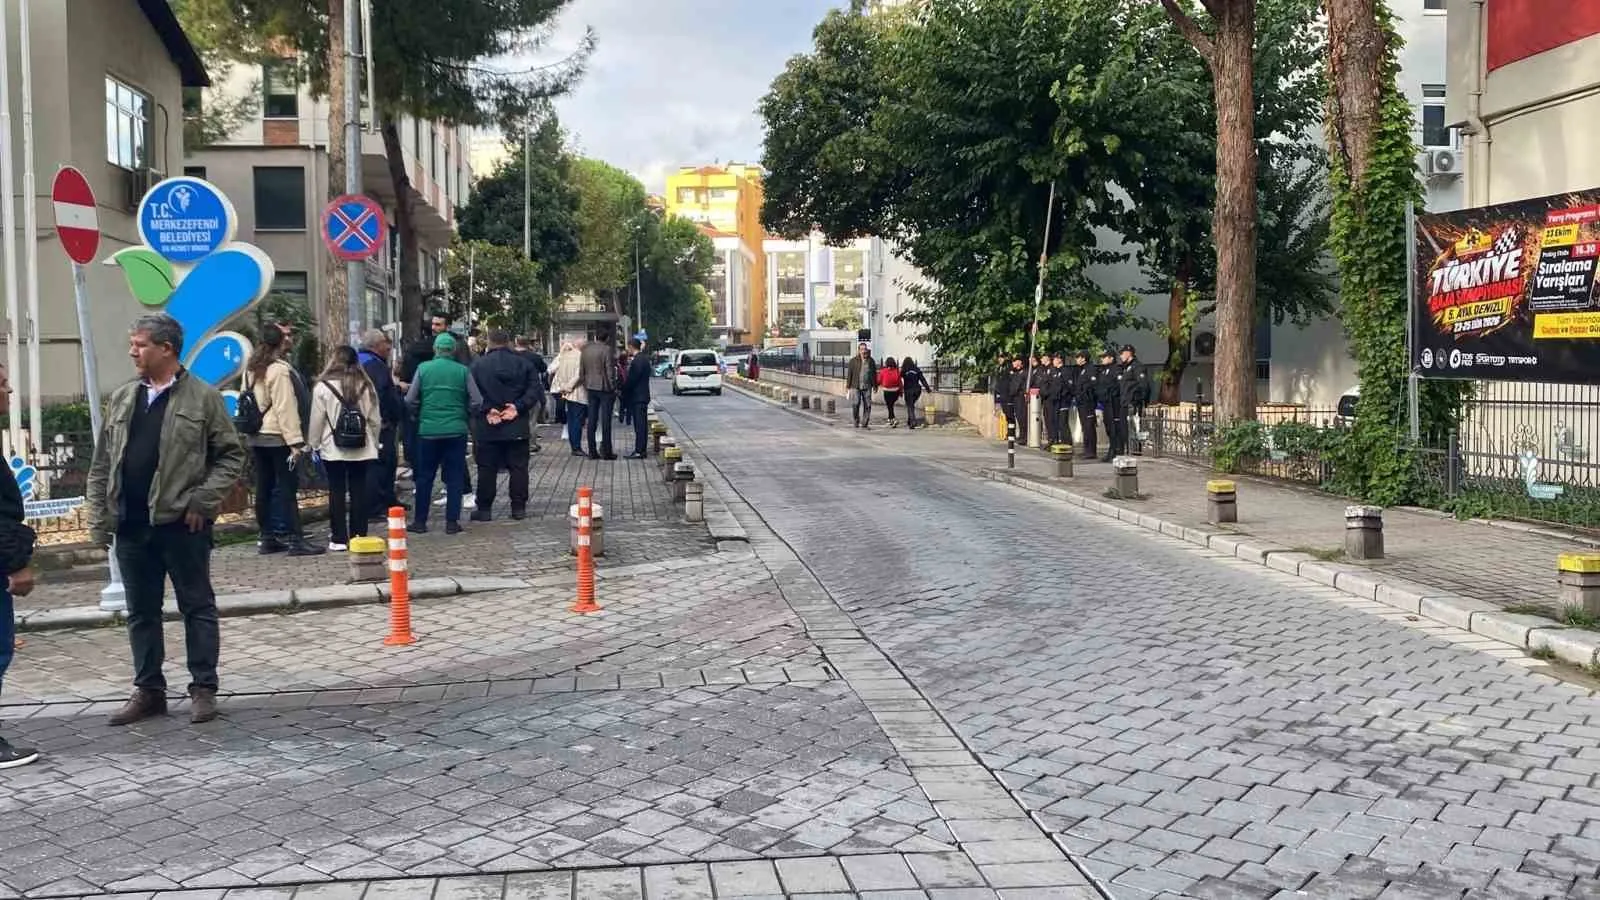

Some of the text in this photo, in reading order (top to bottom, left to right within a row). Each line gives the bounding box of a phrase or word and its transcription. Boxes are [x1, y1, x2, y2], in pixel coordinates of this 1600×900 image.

[150, 202, 173, 219] T.C.
[151, 216, 218, 230] MERKEZEFENDİ
[160, 230, 211, 243] BELEDİYESİ
[1432, 248, 1523, 296] TÜRKİYE
[1539, 260, 1592, 275] Sıralama
[1536, 273, 1584, 291] Yarışları
